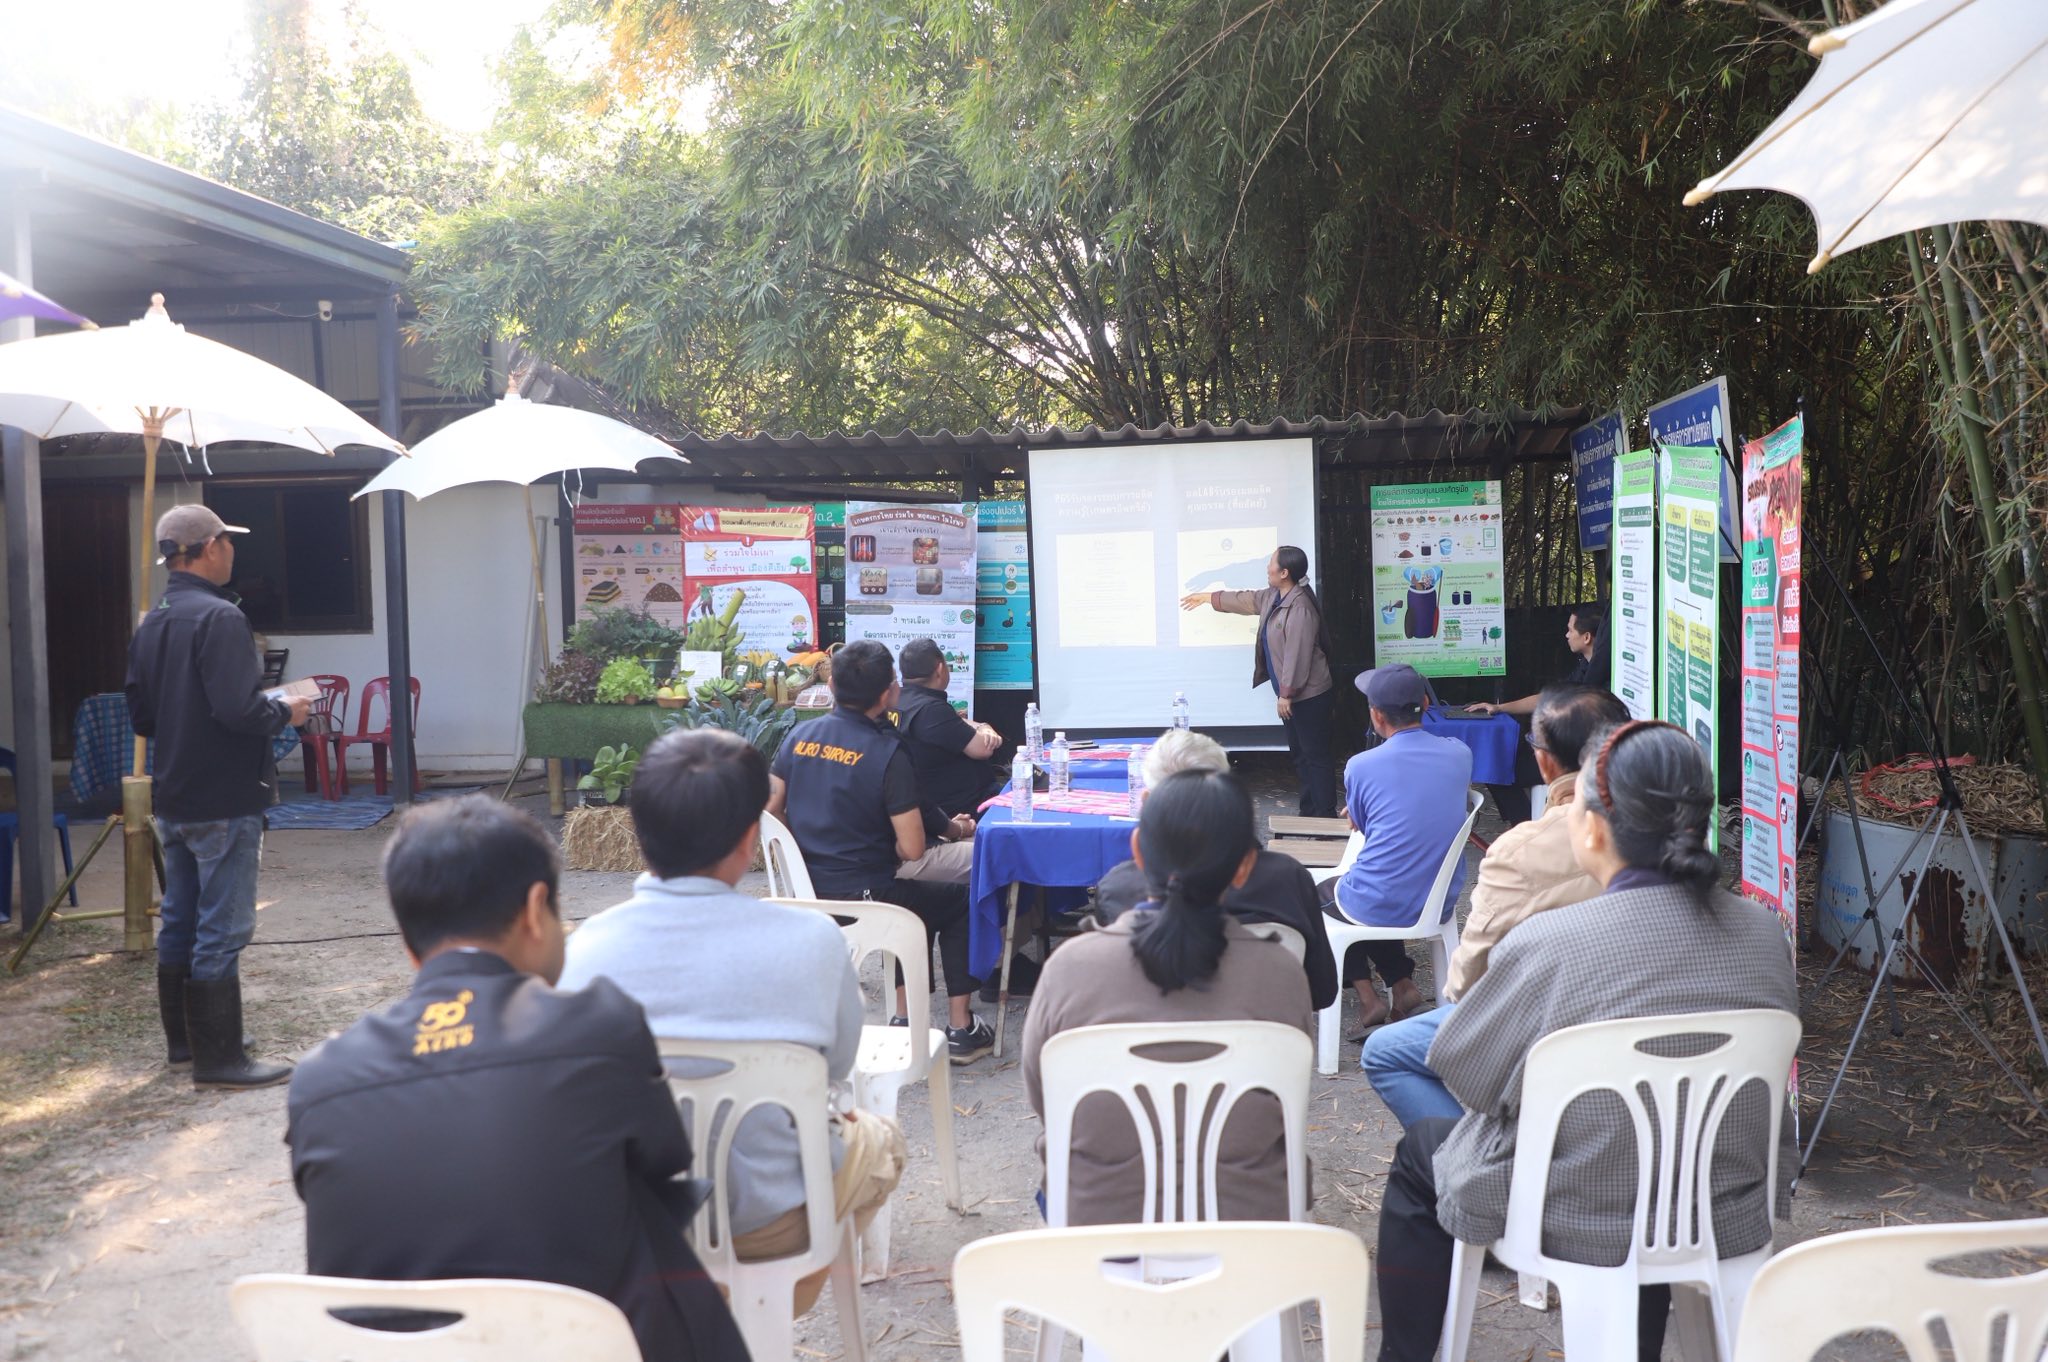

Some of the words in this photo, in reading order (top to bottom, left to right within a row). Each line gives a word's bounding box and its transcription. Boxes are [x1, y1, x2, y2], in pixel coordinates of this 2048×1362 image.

[813, 511, 833, 522] ด.2
[895, 510, 914, 519] ร่วมใจ
[723, 547, 774, 557] ร่วมใจไม่เผา
[792, 740, 820, 757] ALRO
[820, 745, 864, 766] SURVEY
